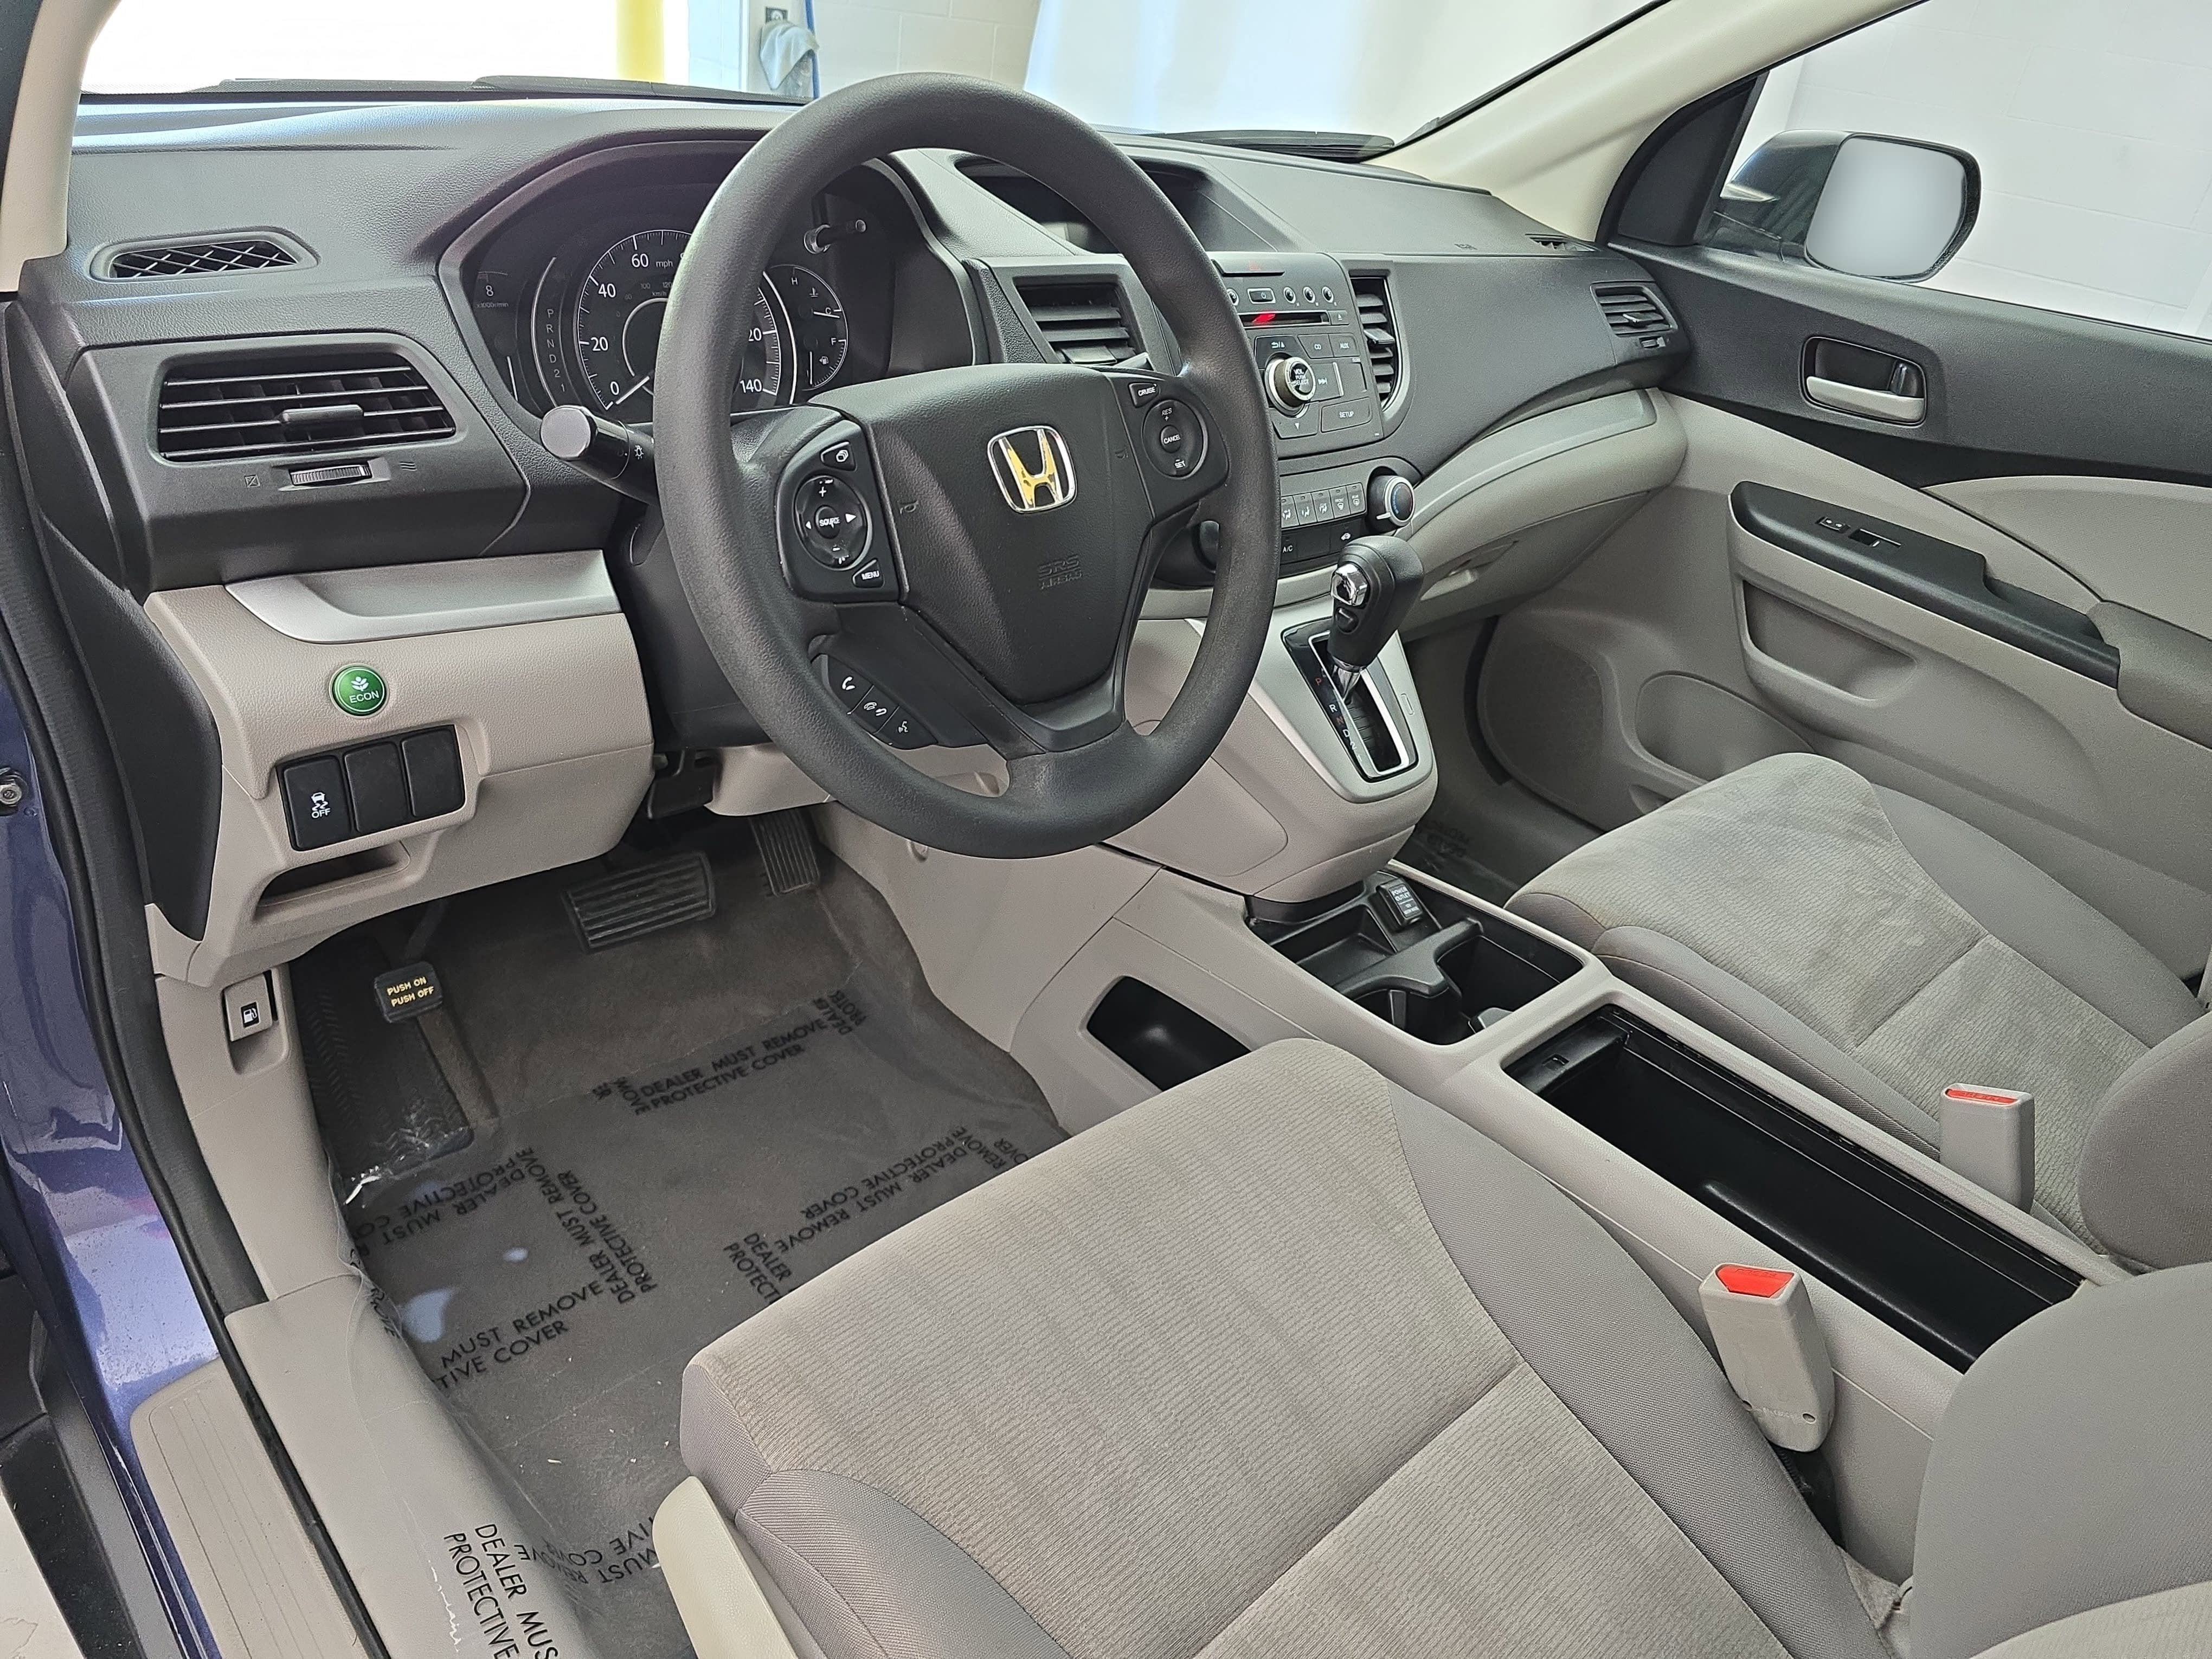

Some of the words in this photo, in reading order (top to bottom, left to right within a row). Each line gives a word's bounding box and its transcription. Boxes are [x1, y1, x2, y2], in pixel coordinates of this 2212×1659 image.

[632, 253, 649, 267] 60
[656, 259, 673, 268] mph
[792, 277, 798, 285] H
[486, 285, 494, 297] 8
[598, 283, 616, 298] 40
[547, 309, 554, 318] P
[546, 324, 554, 333] R
[748, 327, 762, 342] 20
[546, 339, 555, 348] N
[590, 337, 608, 351] 20
[831, 338, 837, 346] F
[549, 354, 557, 363] D
[554, 369, 561, 378] 2
[561, 383, 565, 392] 1
[610, 381, 619, 395] 0
[740, 378, 762, 393] 140
[1138, 387, 1156, 396] CRUISE
[1162, 408, 1172, 416] RES
[1174, 460, 1186, 468] SET
[819, 517, 840, 528] SOURCE
[861, 570, 879, 580] MENU
[1315, 678, 1322, 686] P
[349, 690, 380, 704] ECON
[1329, 704, 1338, 713] R
[1342, 729, 1351, 738] D
[311, 808, 331, 819] OFF
[387, 982, 411, 995] PUSH
[414, 976, 427, 987] ON
[391, 993, 416, 1007] PUSH
[417, 986, 434, 998] OFF
[641, 1067, 704, 1097] DEALER
[711, 1046, 756, 1072] MUST
[762, 1018, 828, 1051] REMOVE
[652, 1065, 749, 1110] PROTECTIVE
[752, 1044, 805, 1071] COVER
[994, 1138, 1029, 1165] OVER
[861, 1136, 955, 1189] PROTECTIVE
[908, 1146, 967, 1184] DEALER
[516, 1147, 564, 1204] REMOVE
[398, 1157, 515, 1219] PROTECTIVE
[452, 1168, 524, 1216] DEALER
[557, 1170, 597, 1214] COVER
[800, 1186, 860, 1220] COVER
[858, 1181, 903, 1213] MUST
[383, 1209, 441, 1245] MUST
[556, 1210, 594, 1246] MUST
[774, 1208, 850, 1252] REMOVE
[589, 1215, 658, 1293] PROTECTIVE
[744, 1232, 792, 1281] DEALER
[589, 1250, 635, 1304] DEALER
[441, 1327, 502, 1368] MUST
[512, 1281, 604, 1334] REMOVE
[494, 1320, 569, 1364] COVER
[474, 1523, 527, 1599] DEALER
[443, 1533, 520, 1659] PROTECTIVE
